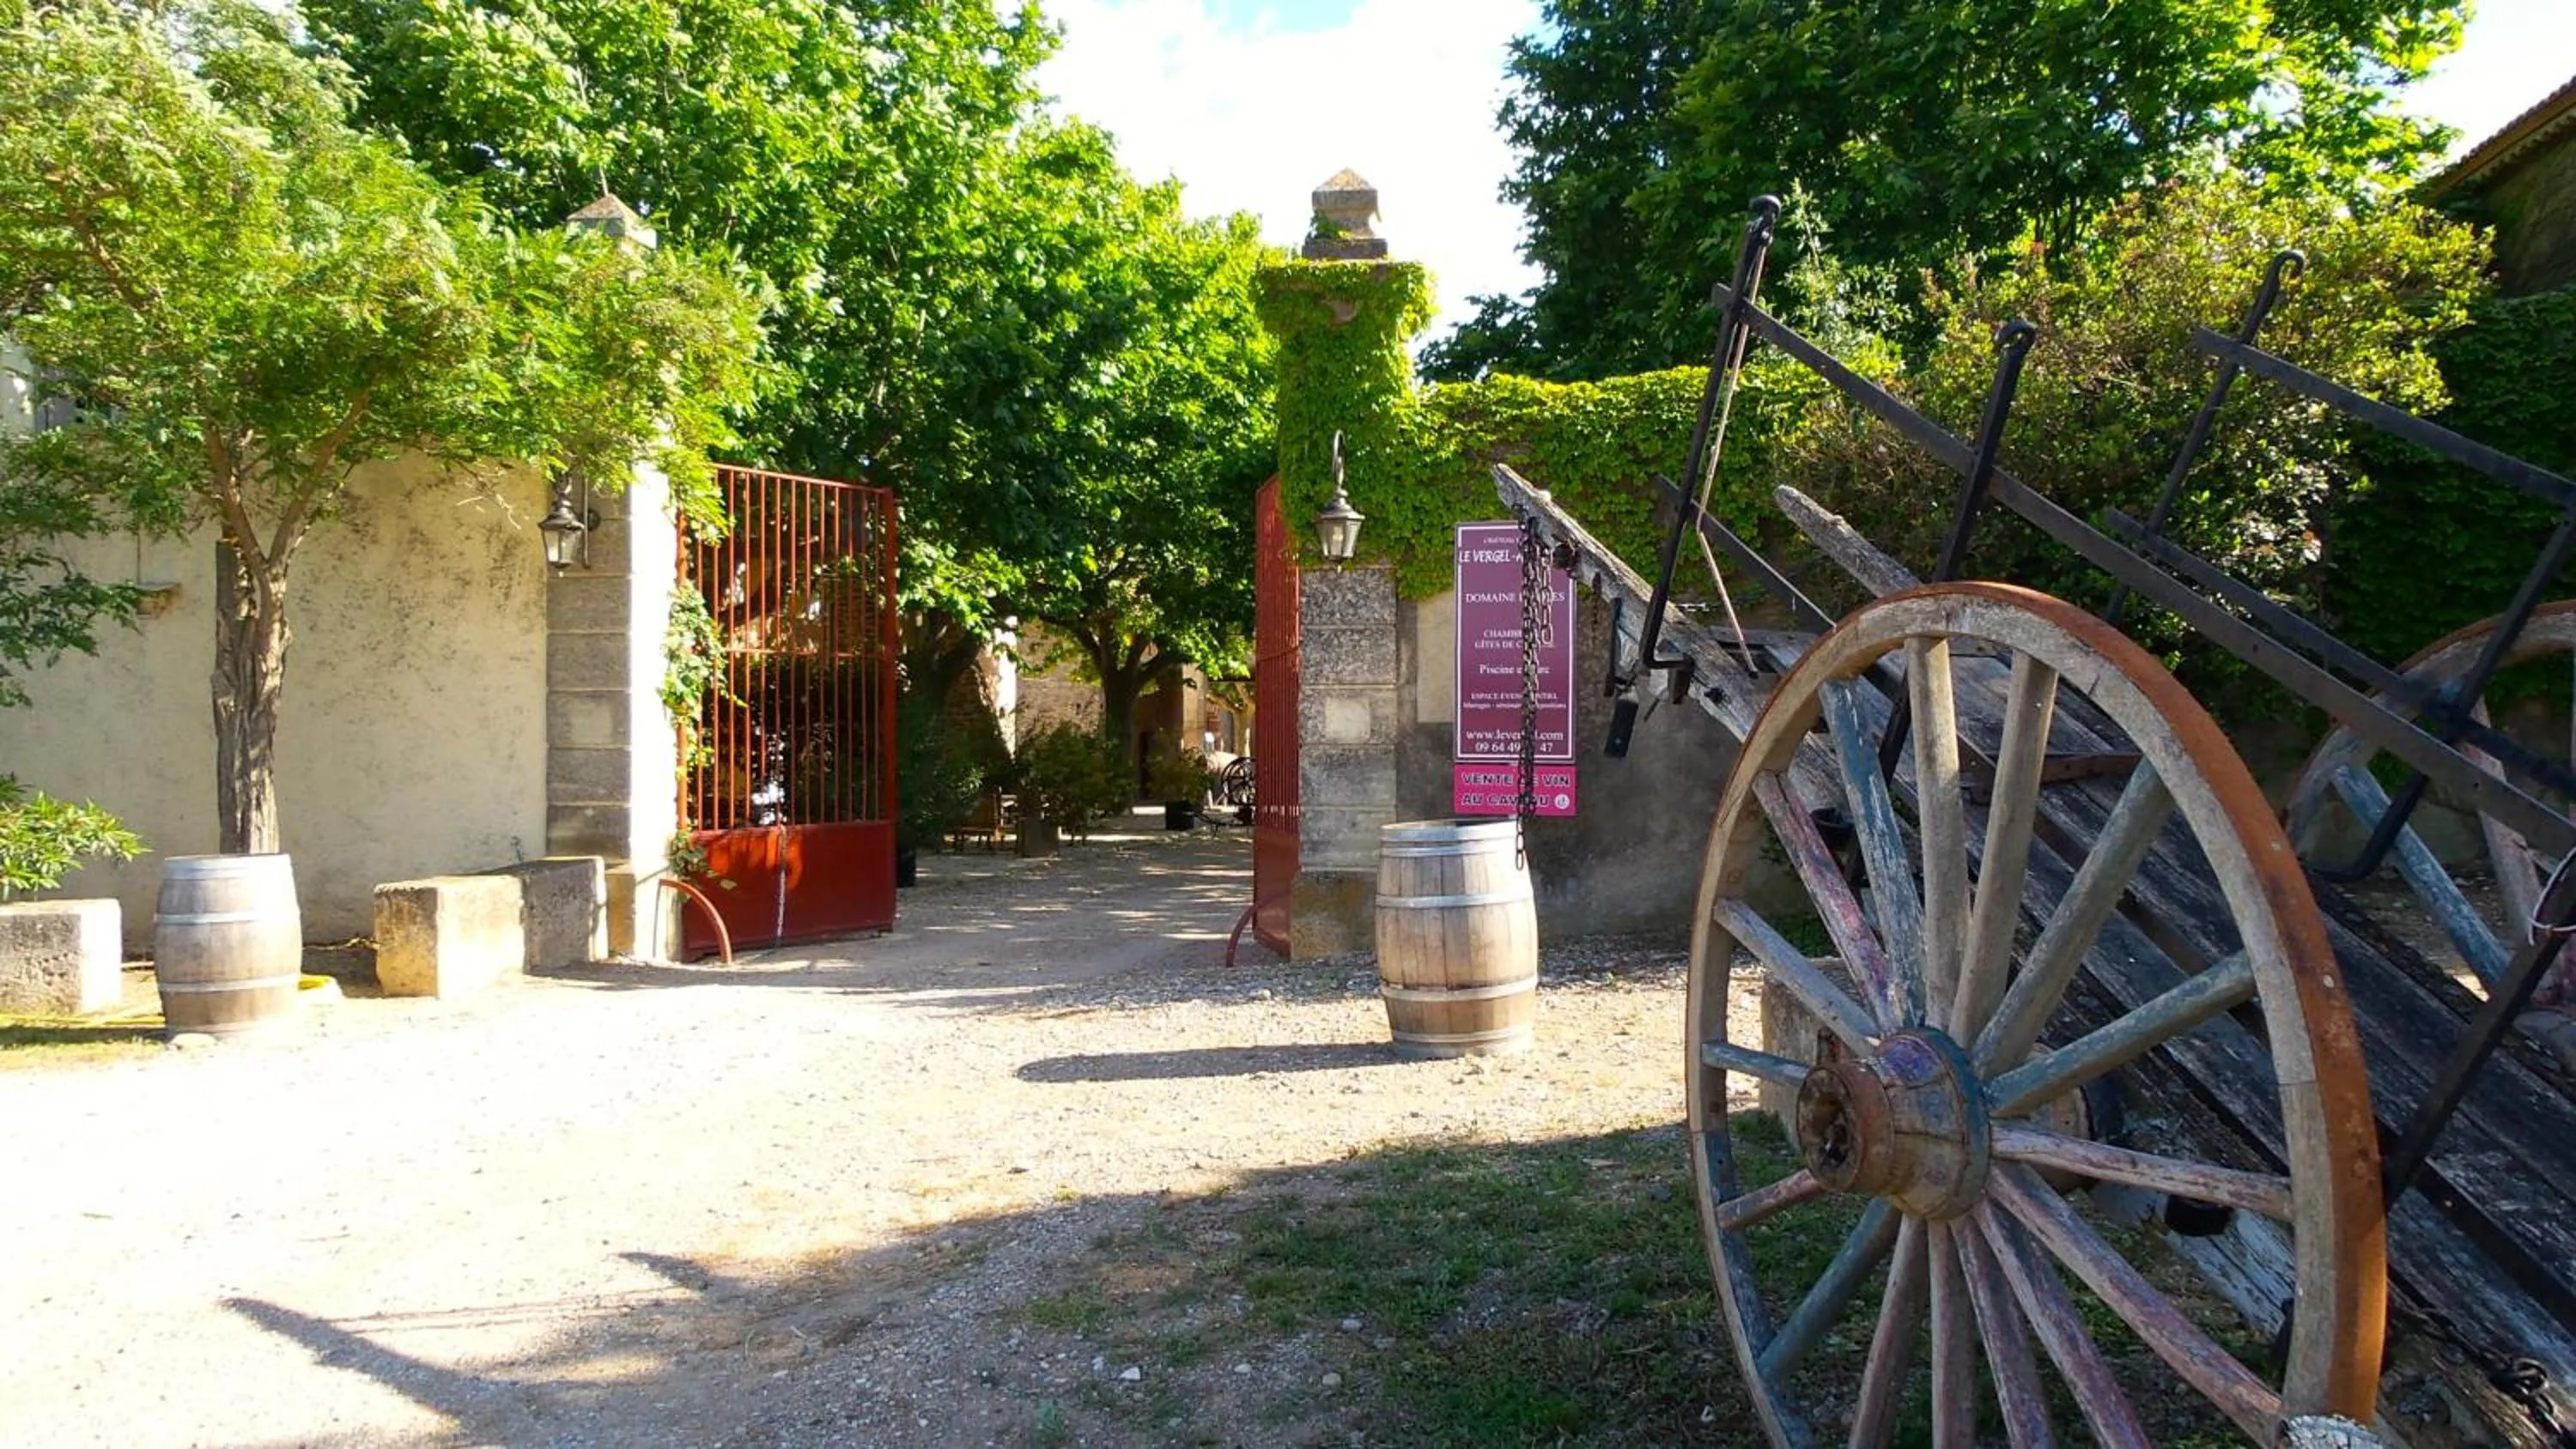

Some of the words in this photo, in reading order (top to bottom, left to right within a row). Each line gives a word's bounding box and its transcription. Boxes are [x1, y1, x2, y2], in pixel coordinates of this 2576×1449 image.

[1459, 549, 1471, 562] LE
[1466, 593, 1515, 603] DOMAINE
[1479, 664, 1514, 674] Piscine
[1475, 742, 1490, 753] 09
[1492, 742, 1505, 753] 64
[1507, 742, 1521, 753] 49
[1540, 743, 1553, 753] 47
[1461, 772, 1514, 786] VENTE
[1541, 773, 1571, 787] VIN
[1461, 792, 1484, 806] AU
[1486, 793, 1550, 808] CAVU
